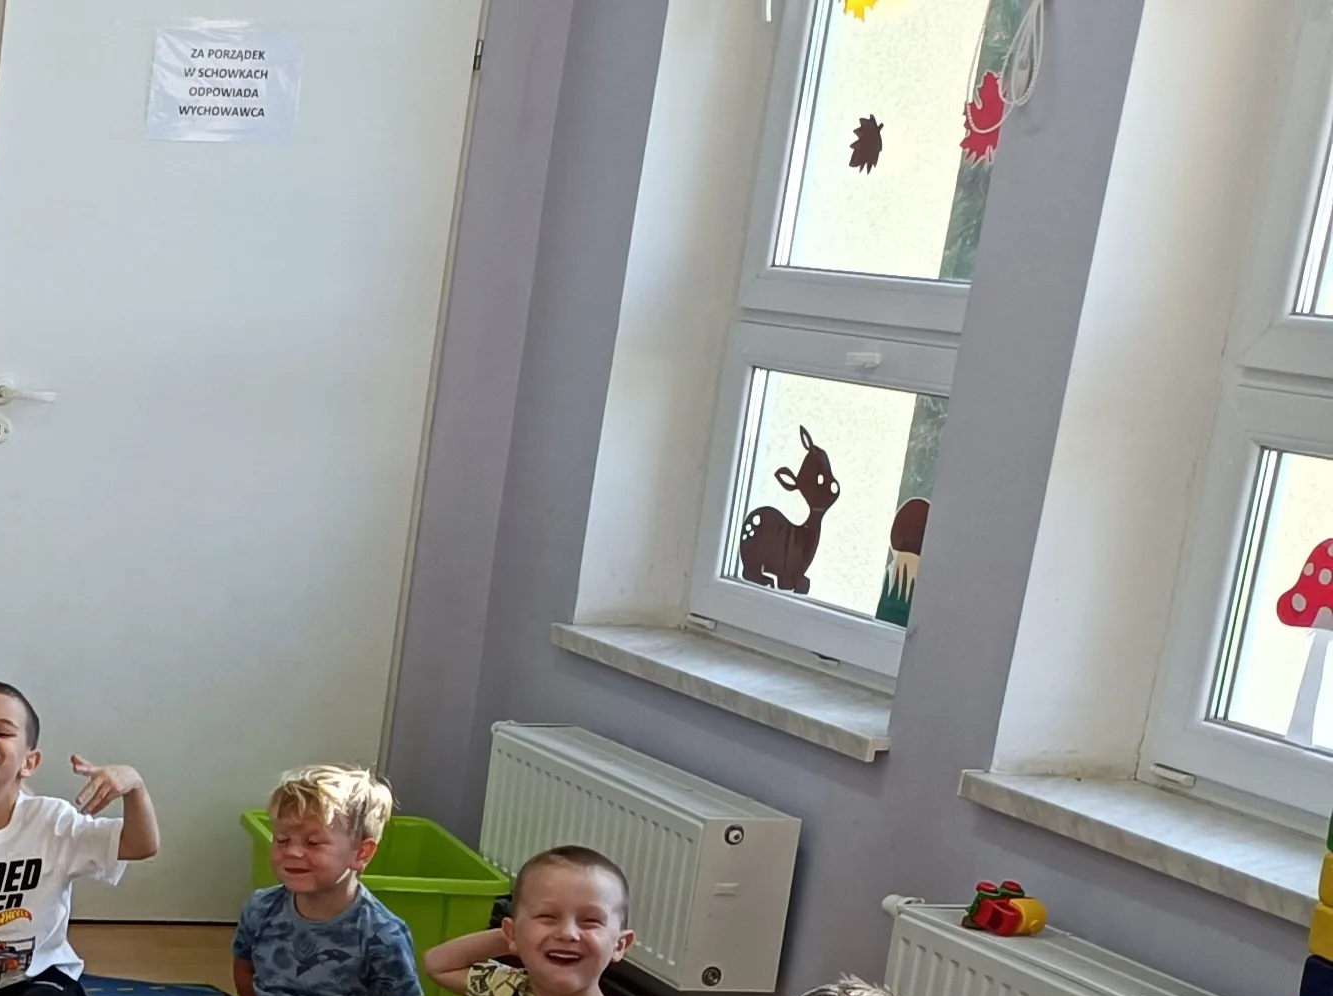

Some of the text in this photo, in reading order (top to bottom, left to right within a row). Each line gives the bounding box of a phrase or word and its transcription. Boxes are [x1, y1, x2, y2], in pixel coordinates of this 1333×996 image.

[190, 48, 265, 61] ZA PORZĄDEK
[183, 67, 268, 79] W SCHOWKACH
[189, 86, 259, 98] ODPOWIADA
[178, 105, 265, 117] WYCHOWAWCA
